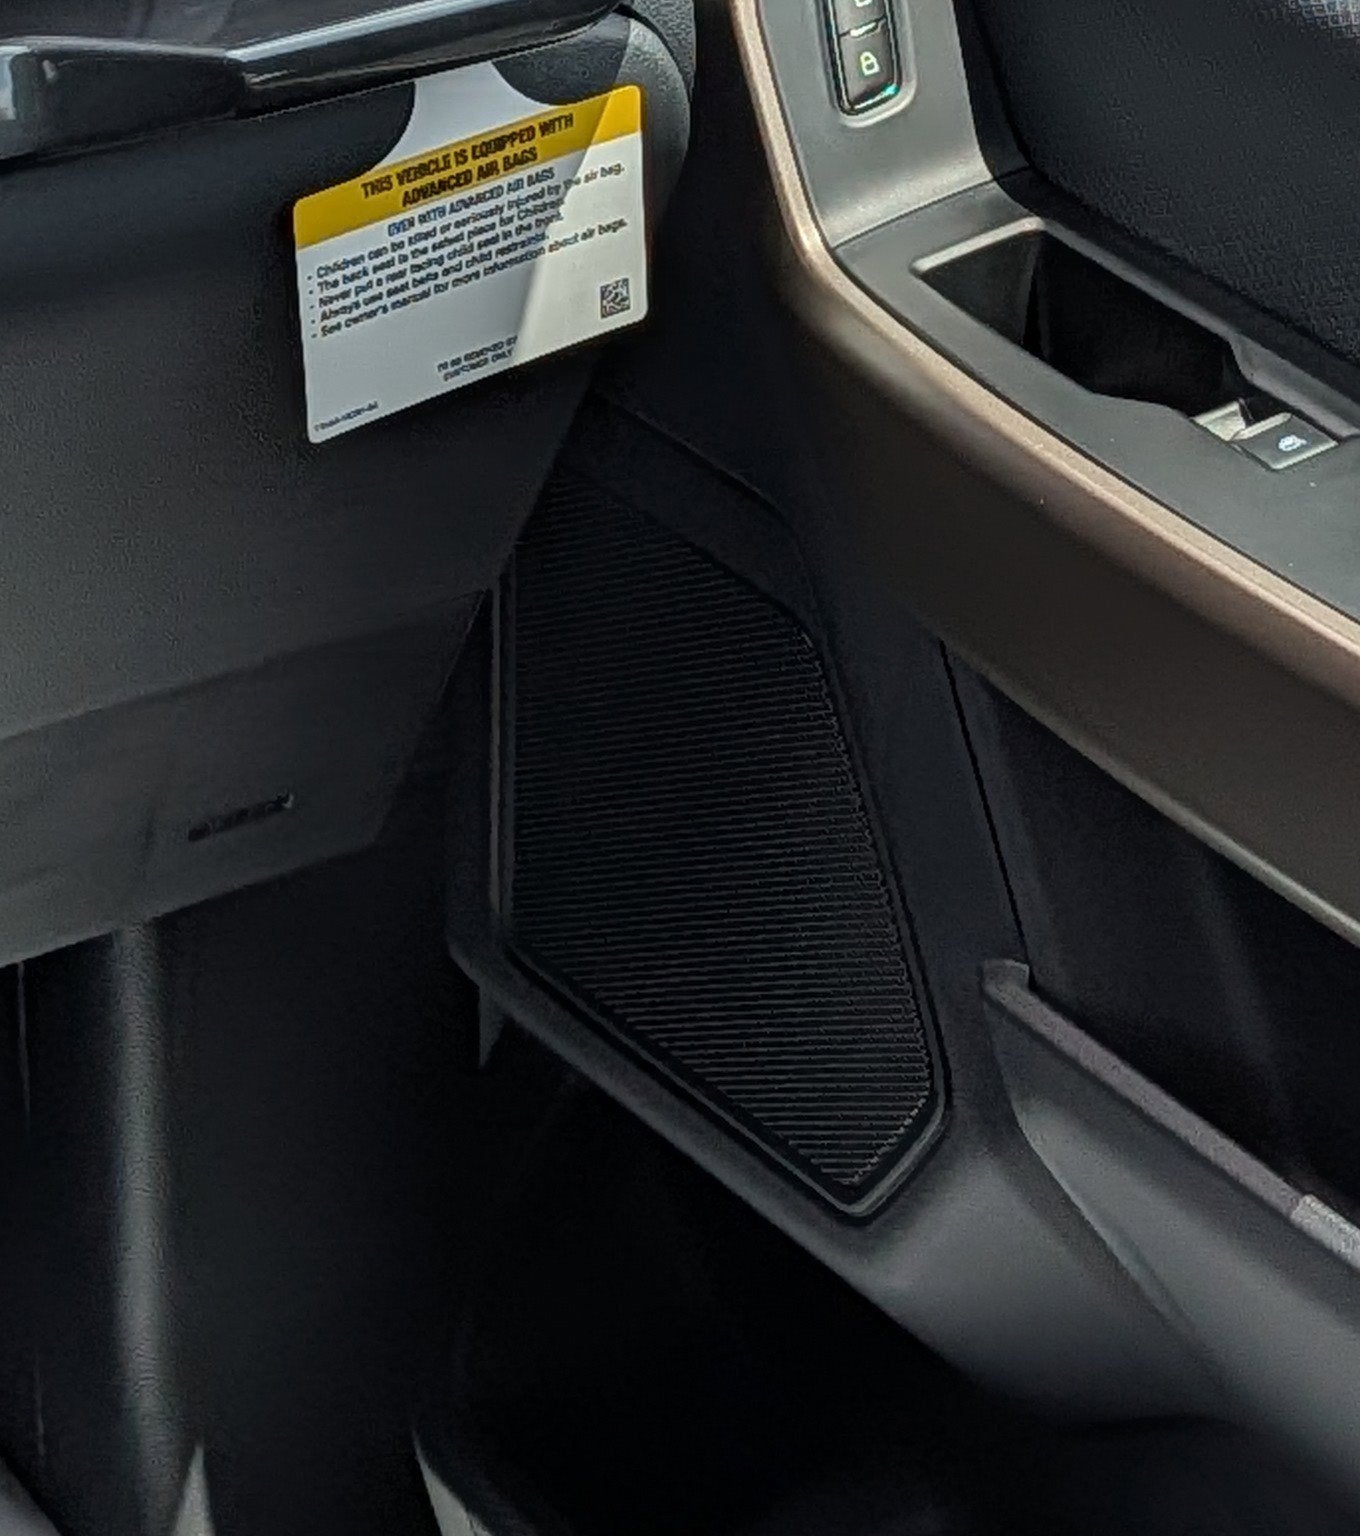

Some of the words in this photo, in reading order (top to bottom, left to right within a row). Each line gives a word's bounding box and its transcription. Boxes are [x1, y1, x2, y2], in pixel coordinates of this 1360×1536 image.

[360, 174, 394, 199] THIS
[396, 152, 451, 187] VEHICLE
[454, 148, 469, 167] IS
[471, 125, 536, 160] EQUIPPED
[538, 113, 574, 139] WITH
[401, 168, 473, 208] ADVANCED
[476, 159, 501, 182] AIR
[503, 146, 539, 172] BAGS
[316, 254, 366, 279] Children
[367, 246, 389, 261] can
[390, 239, 406, 253] be
[407, 226, 437, 247] killed
[439, 222, 453, 234] or
[453, 203, 506, 230] seriously
[507, 188, 546, 211] injured
[546, 183, 562, 197] by
[562, 176, 582, 192] the
[583, 168, 599, 184] air
[600, 162, 626, 178] bag.
[387, 216, 415, 238] EVEN
[417, 204, 446, 224] WITH
[448, 184, 504, 217] ADVANCED
[506, 177, 525, 196] AIR
[526, 166, 556, 186] BAGS
[317, 278, 340, 293] The
[341, 266, 370, 285] back
[371, 256, 396, 274] seat
[397, 253, 409, 265] is
[410, 245, 429, 259] the
[431, 232, 465, 252] safest
[467, 221, 497, 242] place
[498, 213, 515, 227] for
[318, 288, 352, 308] Never
[354, 280, 374, 298] put
[375, 276, 384, 287] a
[385, 267, 408, 283] rear
[409, 254, 446, 274] facing
[446, 242, 476, 262] child
[476, 233, 501, 251] seat
[501, 229, 513, 241] in
[514, 221, 533, 236] the
[320, 321, 343, 338] See
[390, 287, 432, 311] manual
[433, 281, 450, 294] for
[451, 270, 481, 287] more
[483, 246, 547, 277] information
[547, 232, 580, 253] about
[580, 228, 596, 241] air
[597, 218, 628, 235] bags.
[320, 299, 361, 322] Always
[362, 291, 384, 306] use
[385, 281, 410, 298] seat
[411, 270, 439, 288] belts
[441, 260, 464, 277] and
[465, 249, 493, 267] child
